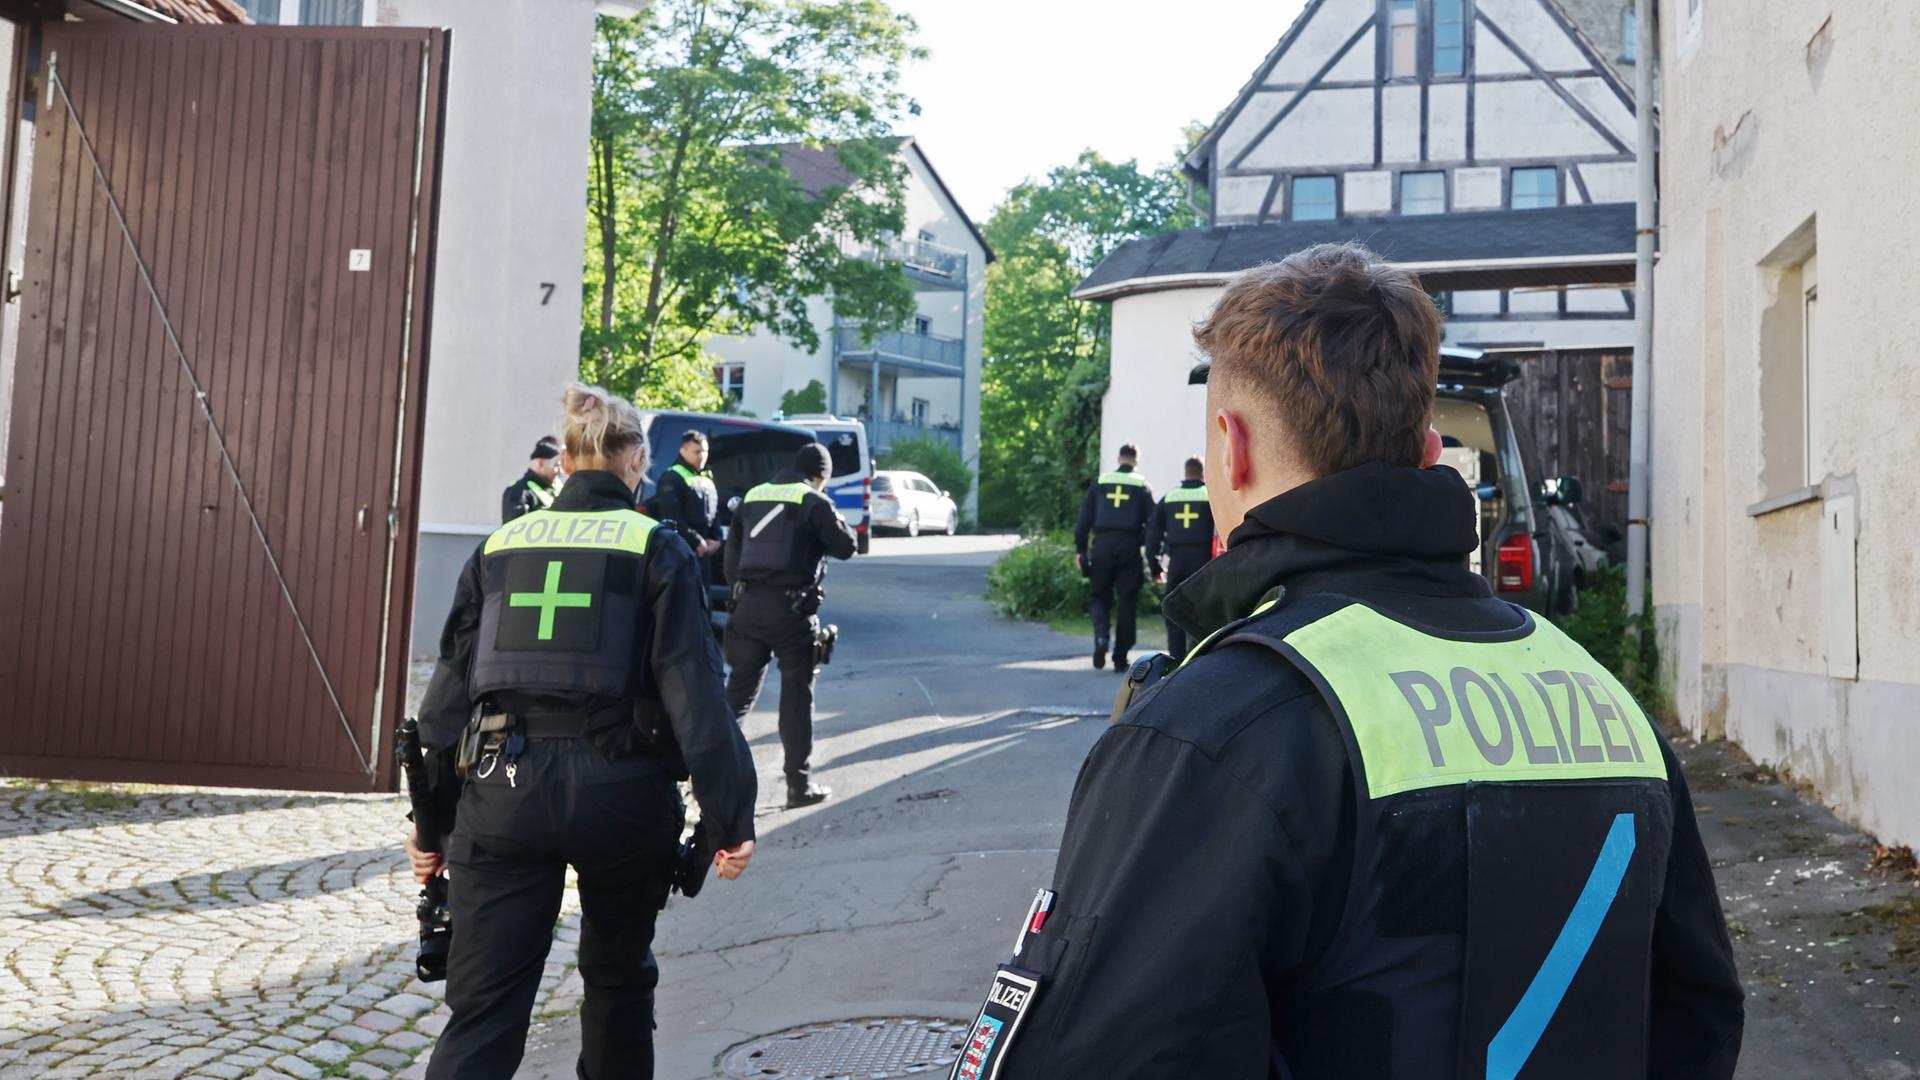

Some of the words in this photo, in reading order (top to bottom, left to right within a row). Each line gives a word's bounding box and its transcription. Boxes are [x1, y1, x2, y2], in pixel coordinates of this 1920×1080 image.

[356, 254, 364, 266] 7
[540, 282, 556, 306] 7
[504, 518, 628, 545] POLIZEI
[1388, 666, 1645, 768] POLIZEI
